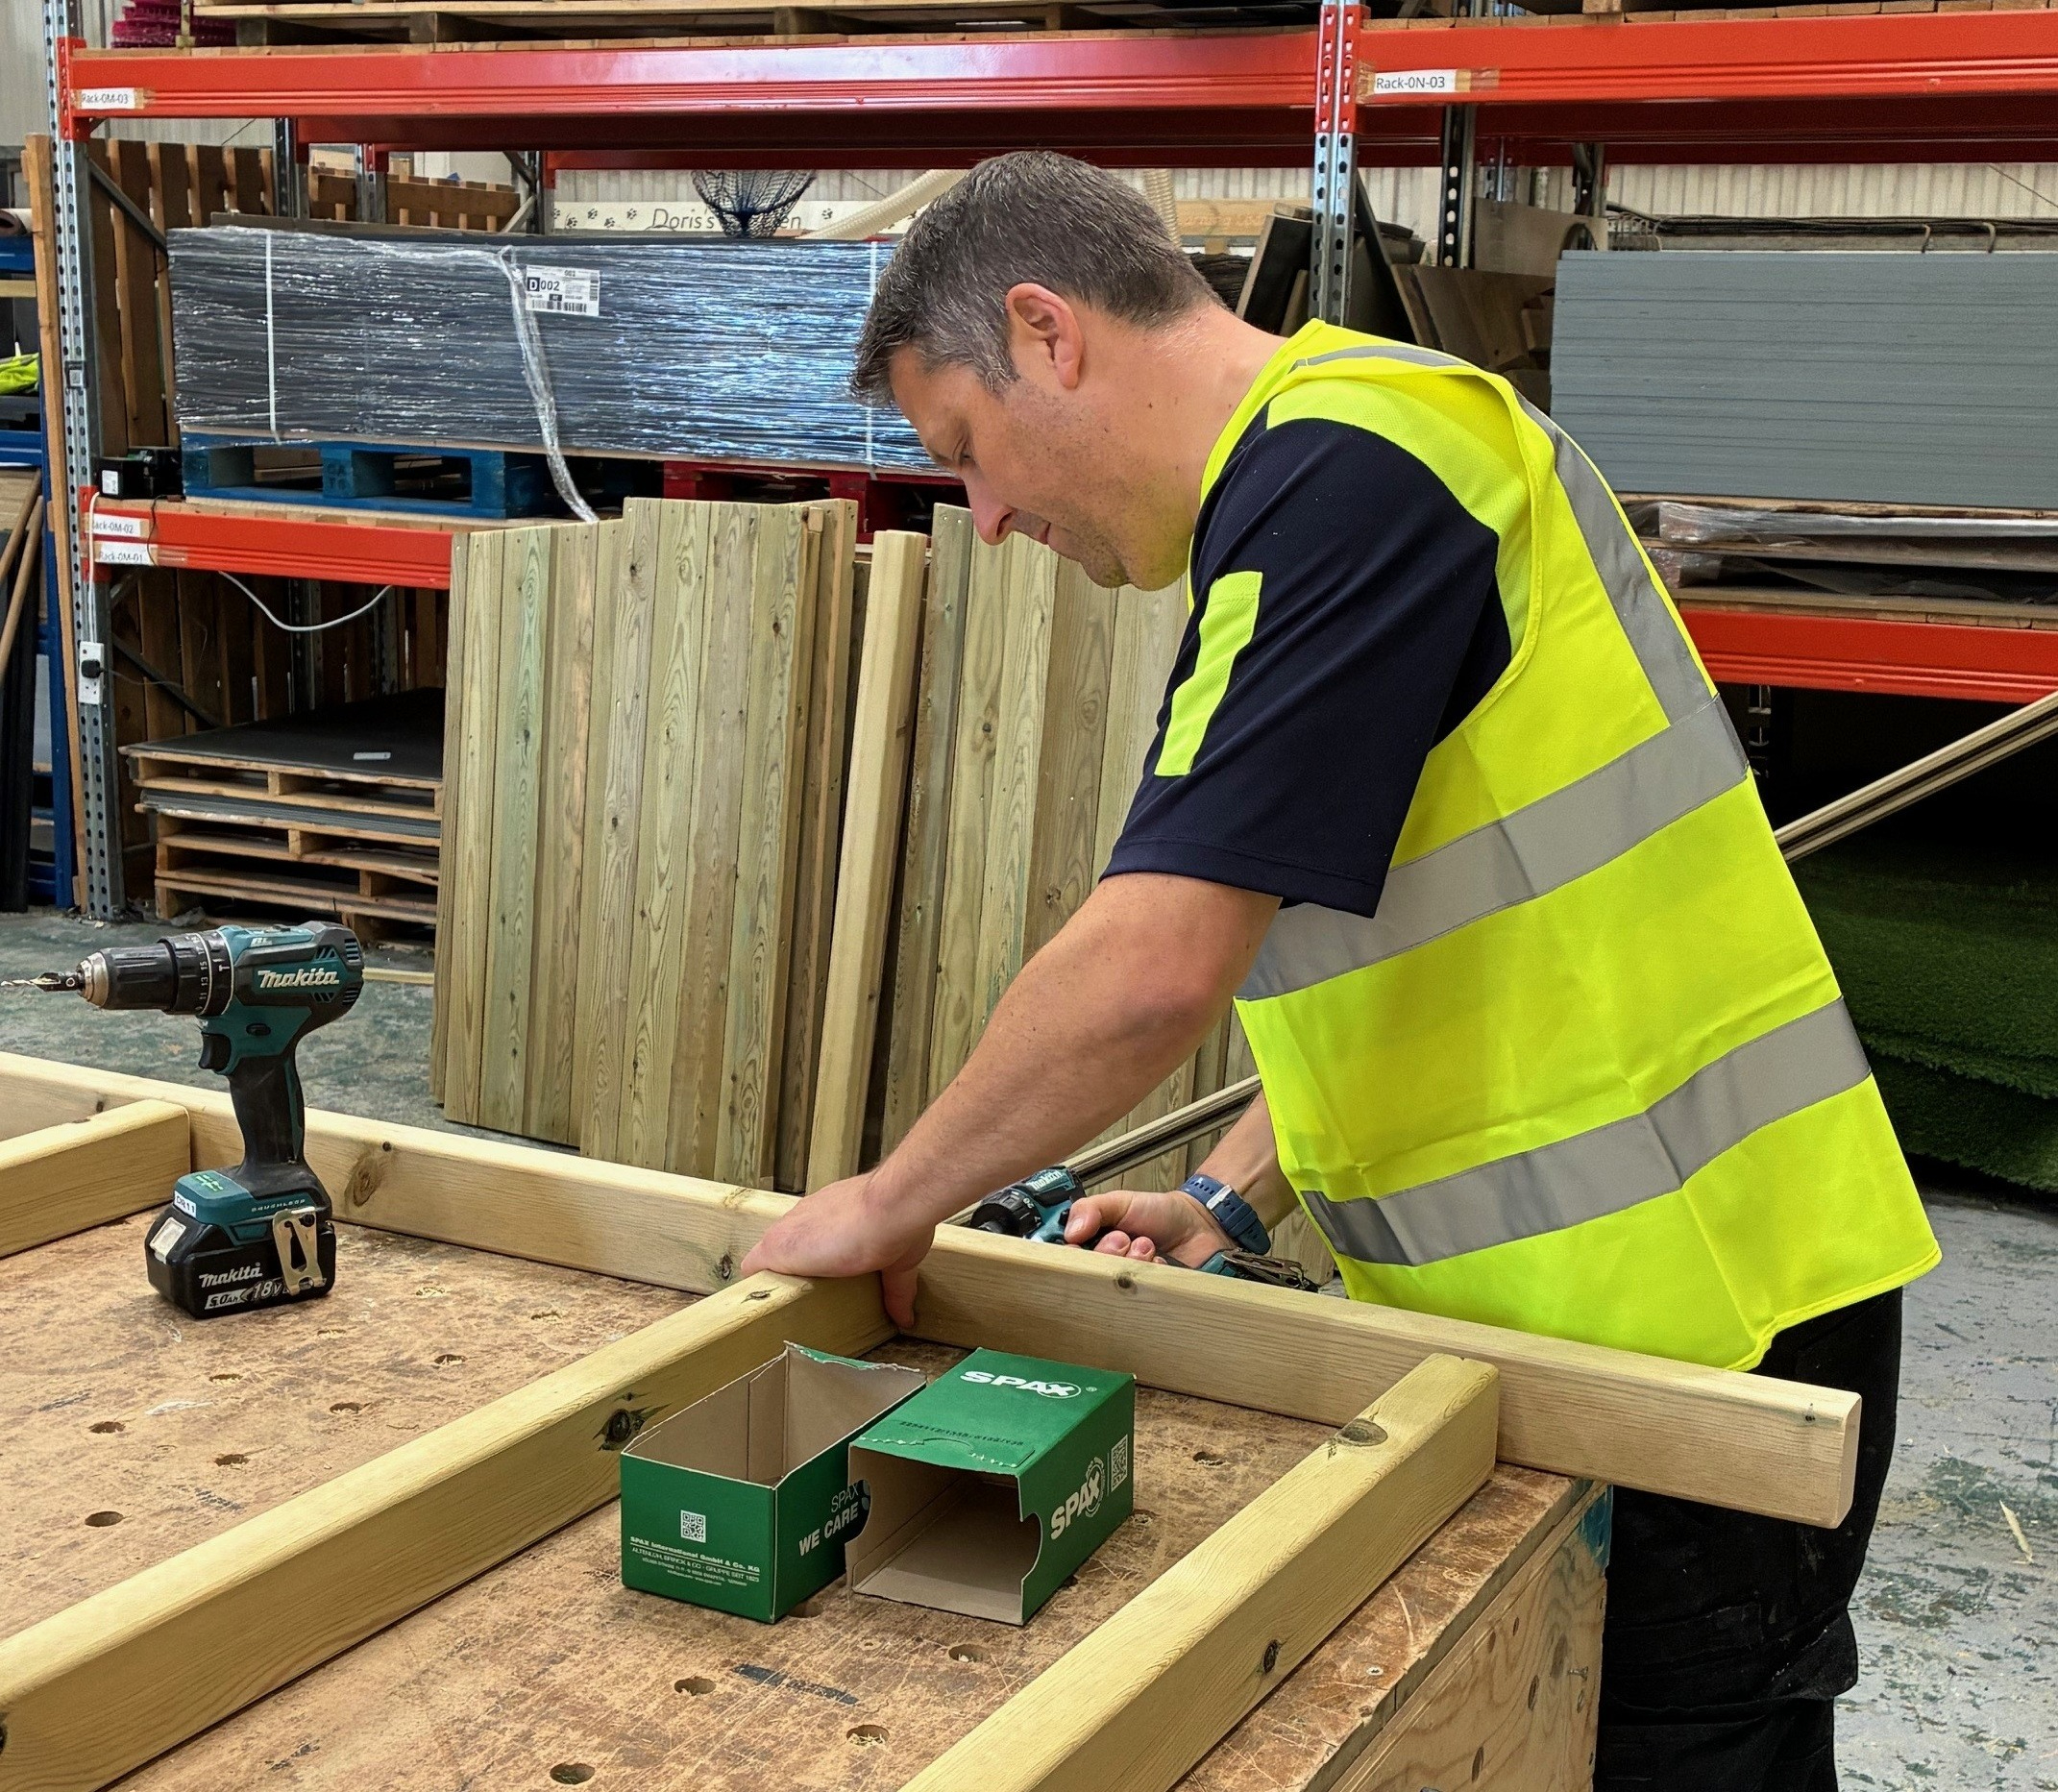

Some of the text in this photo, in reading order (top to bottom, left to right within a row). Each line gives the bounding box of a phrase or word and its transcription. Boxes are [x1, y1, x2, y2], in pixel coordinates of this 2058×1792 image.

[652, 208, 715, 229] Doris's
[200, 976, 208, 986] 13
[960, 1370, 1080, 1398] SPAX
[830, 1483, 859, 1513] SPAX
[1050, 1468, 1102, 1540] SPAX
[798, 1501, 859, 1557] WE CARE
